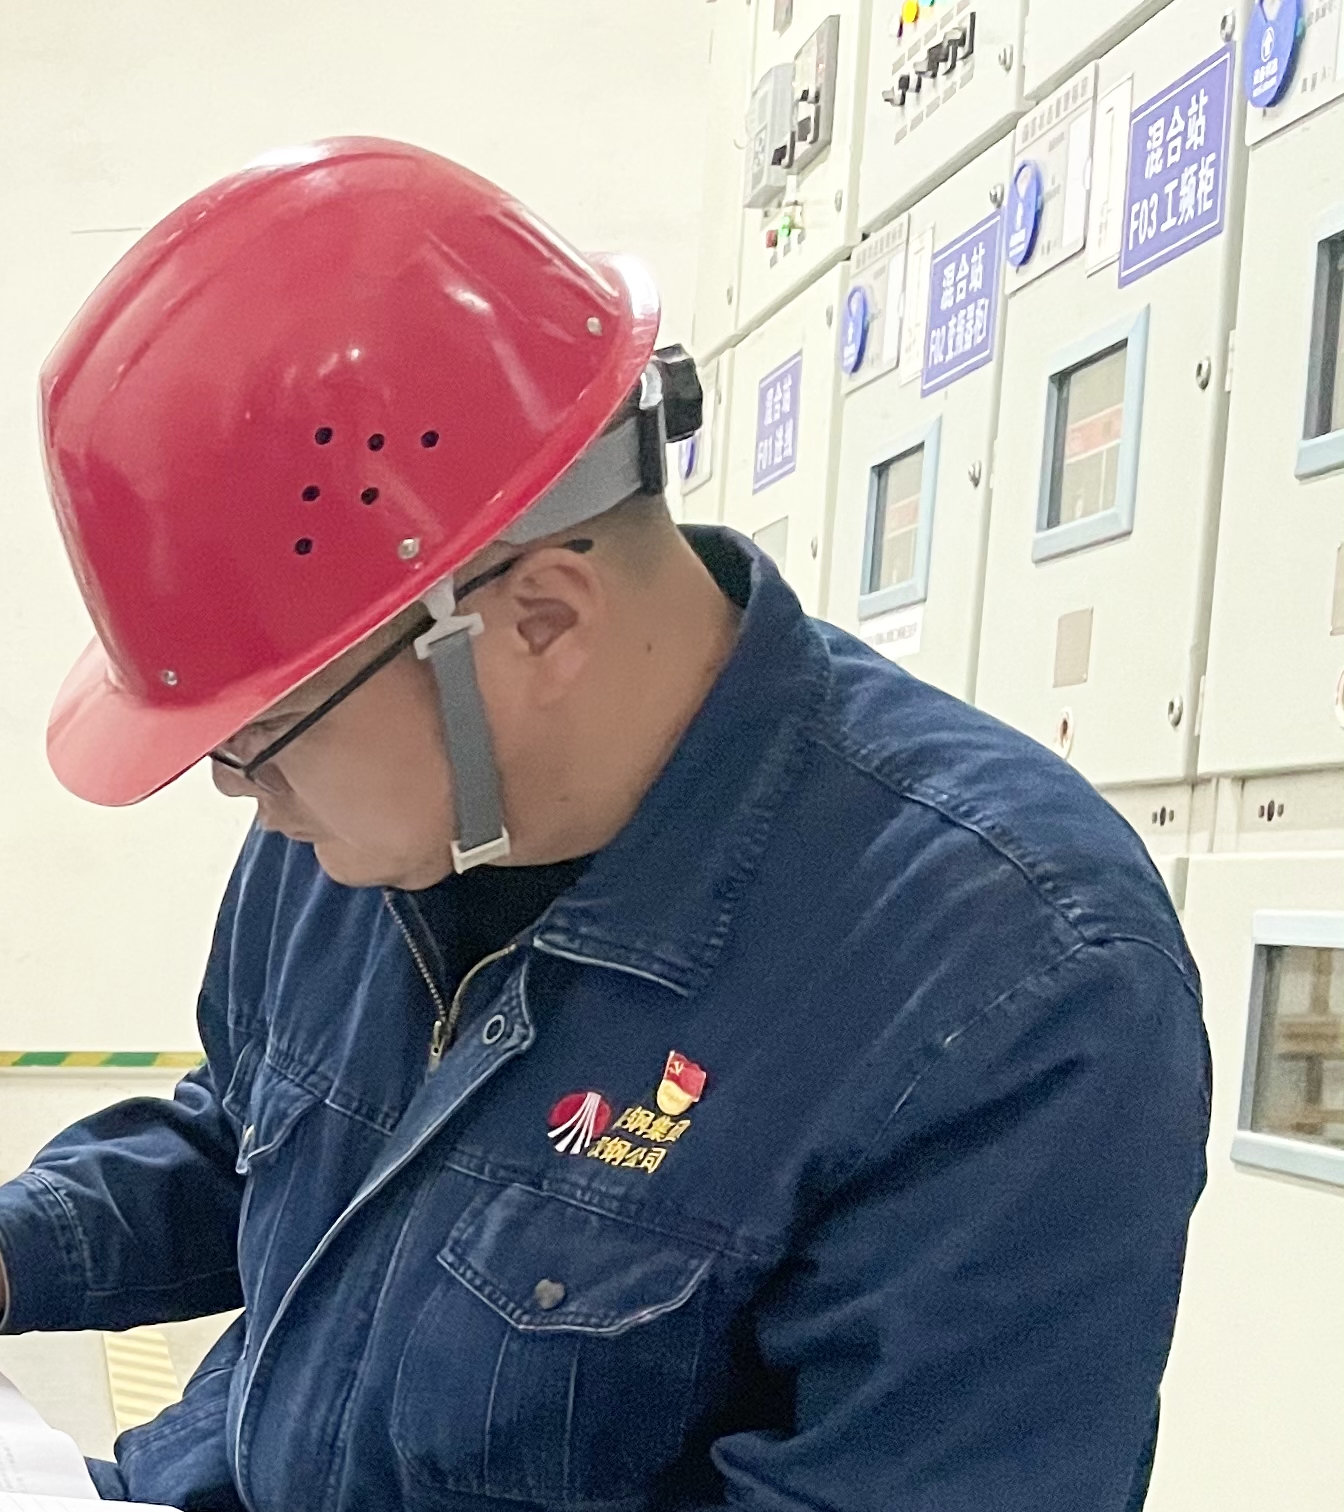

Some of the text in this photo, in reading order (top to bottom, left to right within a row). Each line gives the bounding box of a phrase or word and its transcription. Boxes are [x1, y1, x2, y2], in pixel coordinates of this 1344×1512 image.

[1144, 88, 1208, 180] 混合站
[1128, 152, 1217, 251] F03 工频柜
[940, 241, 986, 311] 混合站
